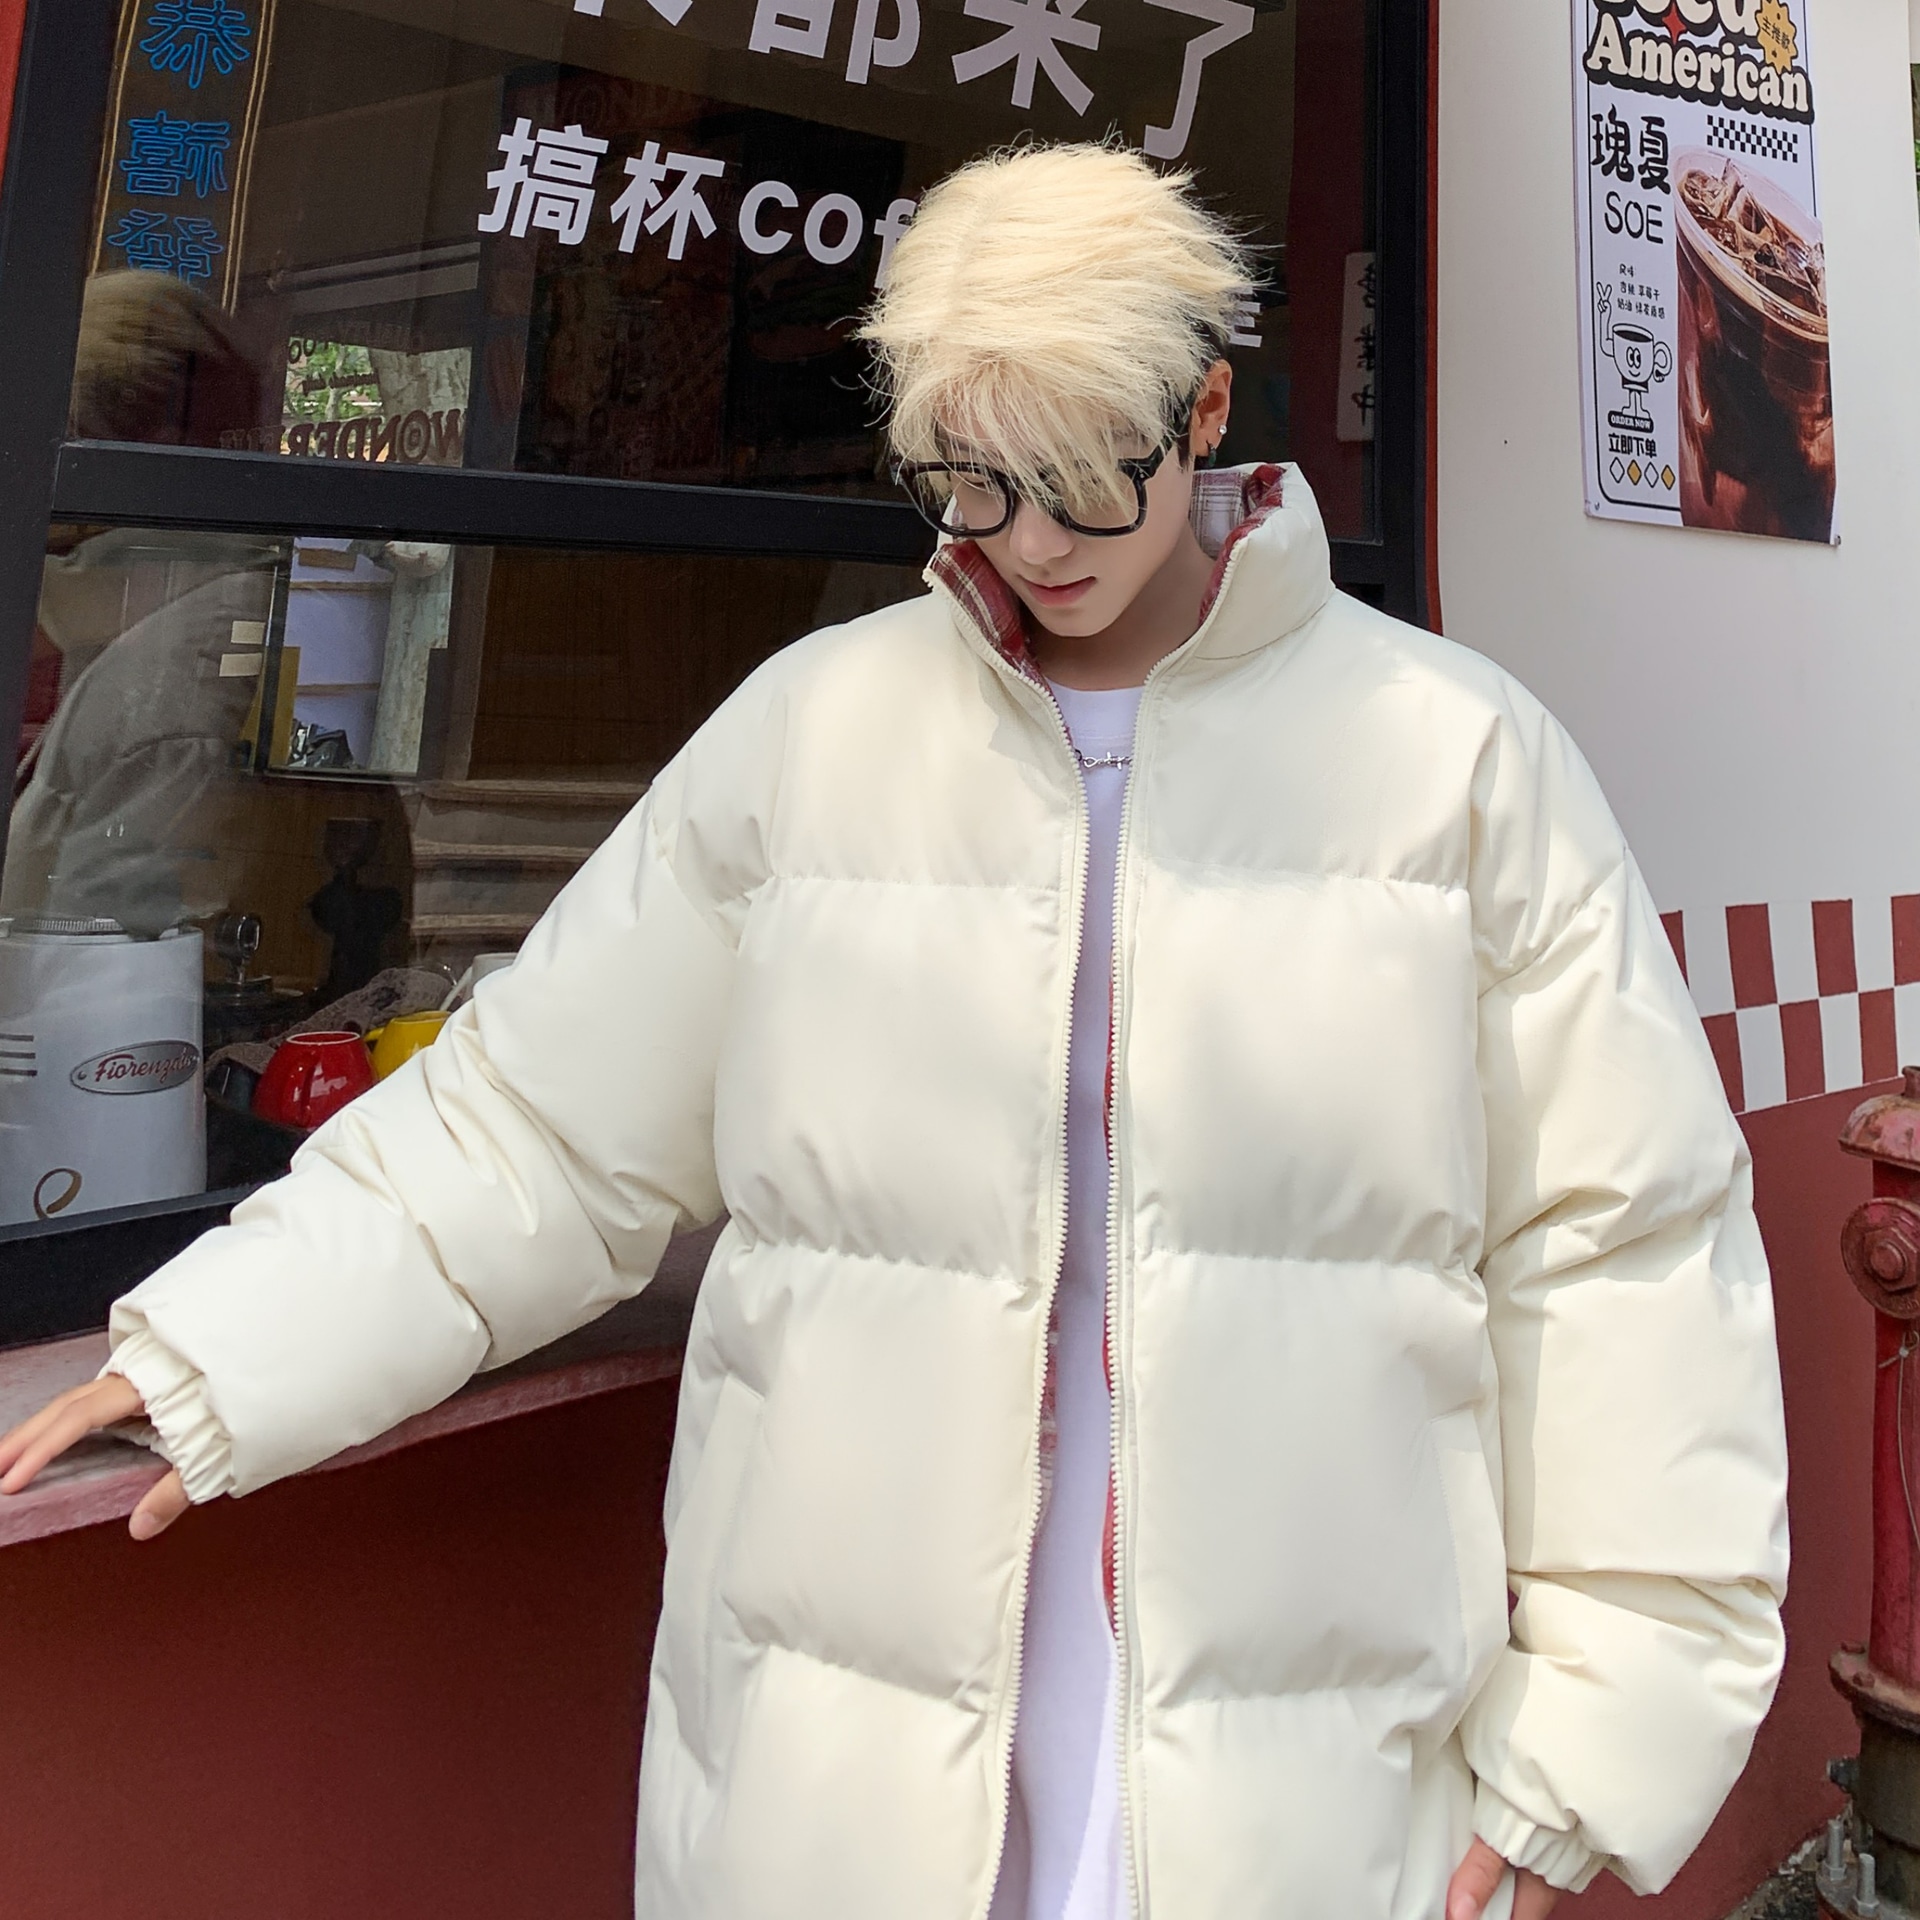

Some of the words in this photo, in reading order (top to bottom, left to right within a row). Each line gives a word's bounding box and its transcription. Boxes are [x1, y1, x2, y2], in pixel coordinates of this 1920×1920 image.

[1586, 11, 1810, 113] American
[1590, 103, 1671, 195] 瑰夏
[1604, 190, 1664, 244] SOE
[1608, 432, 1657, 458] 立即下单
